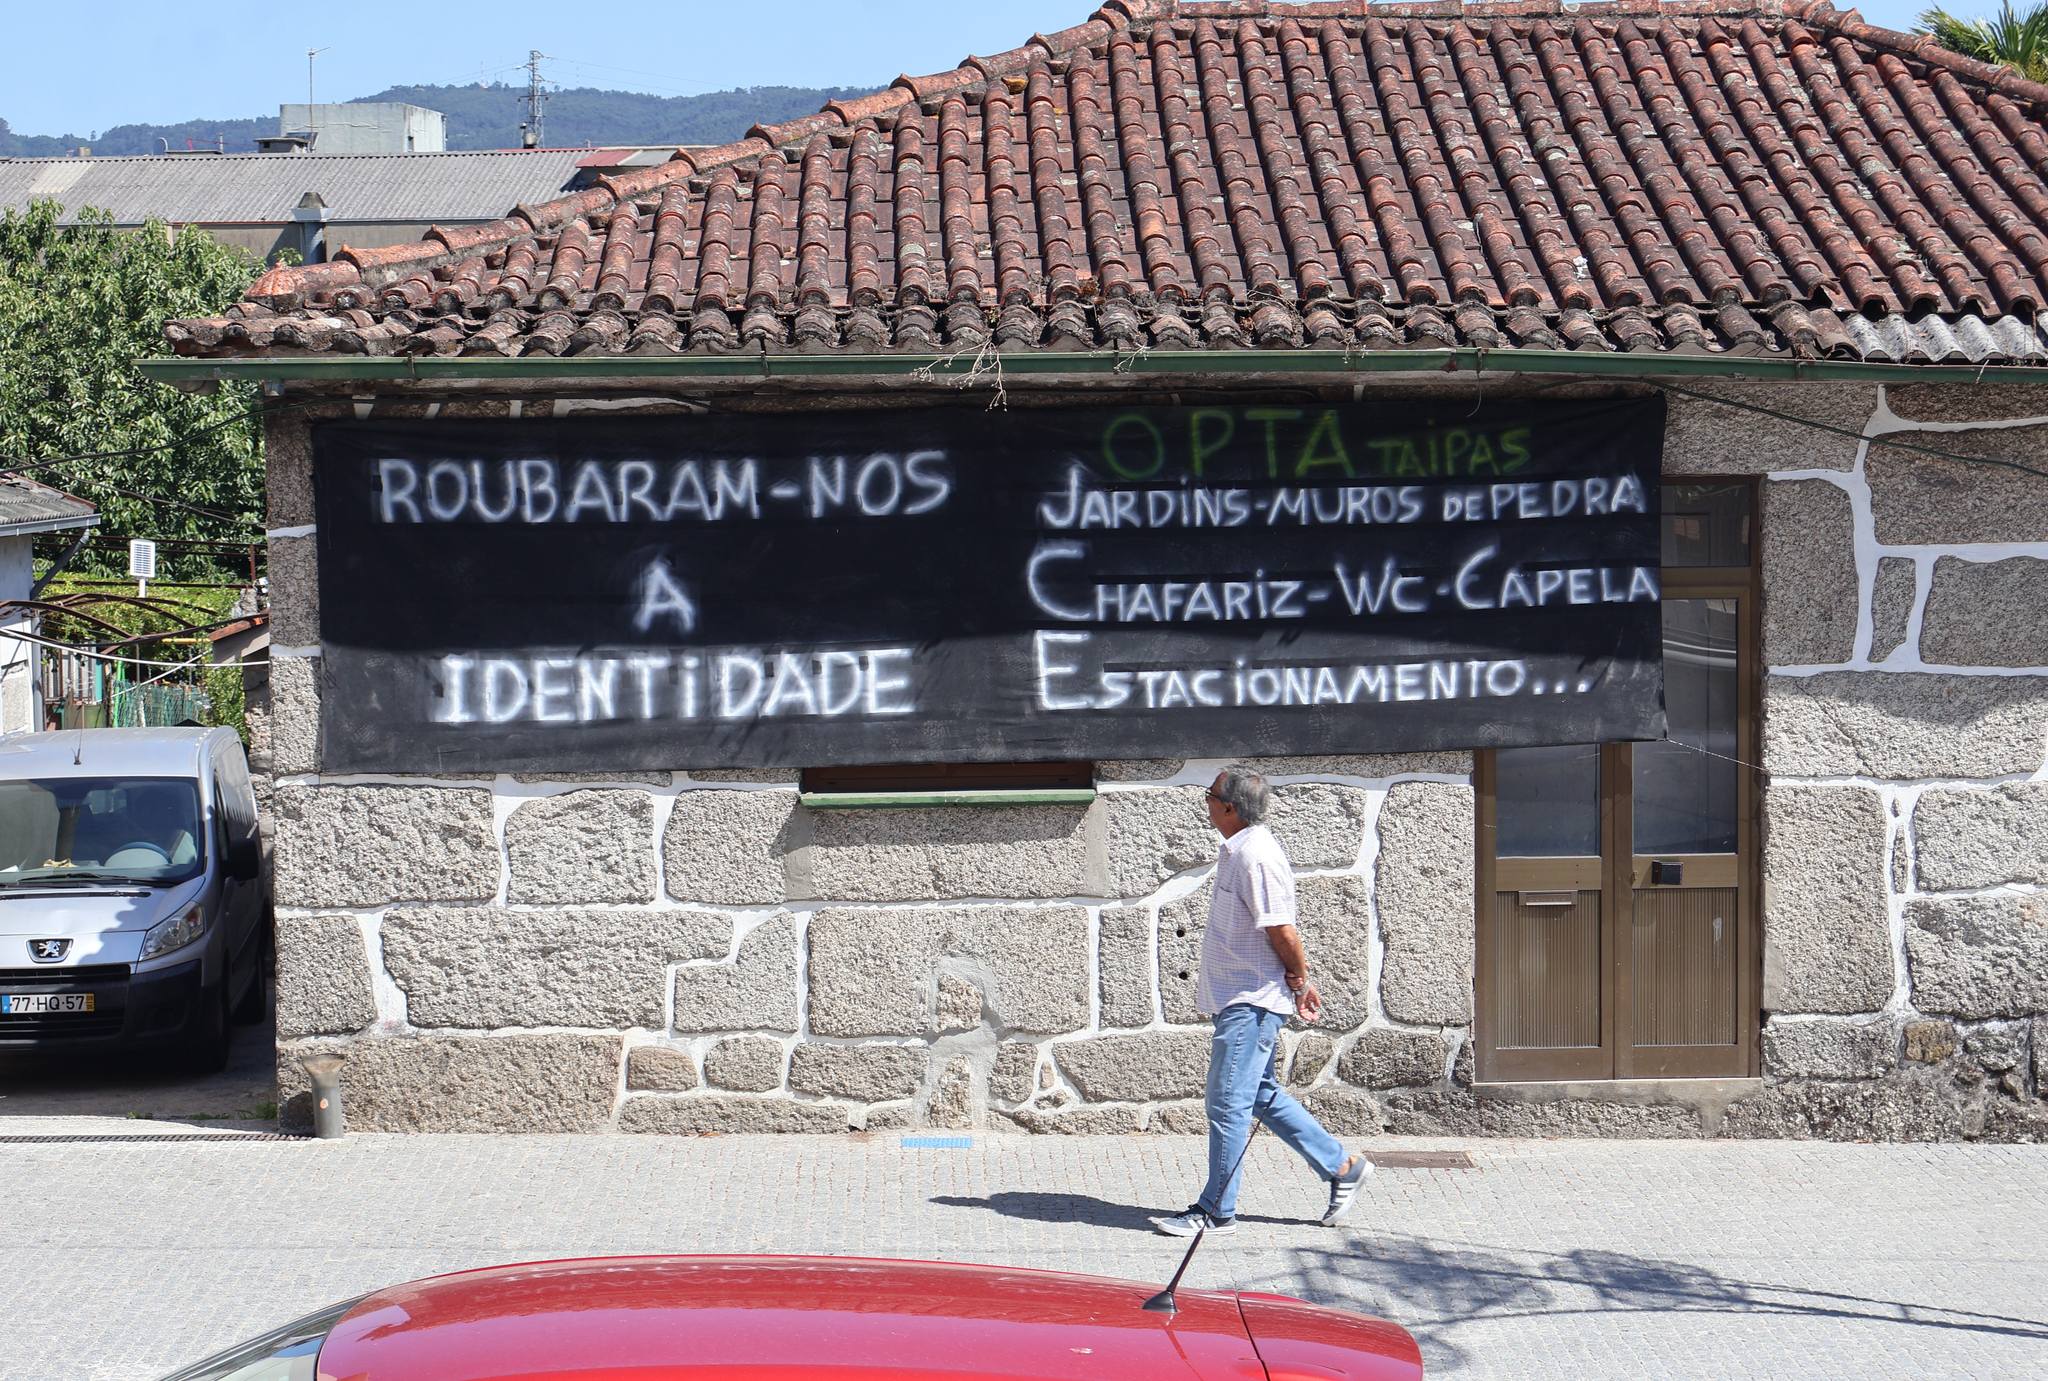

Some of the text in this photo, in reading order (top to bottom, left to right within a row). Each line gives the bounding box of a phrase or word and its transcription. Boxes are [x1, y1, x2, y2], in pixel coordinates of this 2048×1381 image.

[378, 449, 951, 523] ROUBARAM-NOS
[1490, 474, 1648, 520] PEDRA
[634, 558, 695, 631] A
